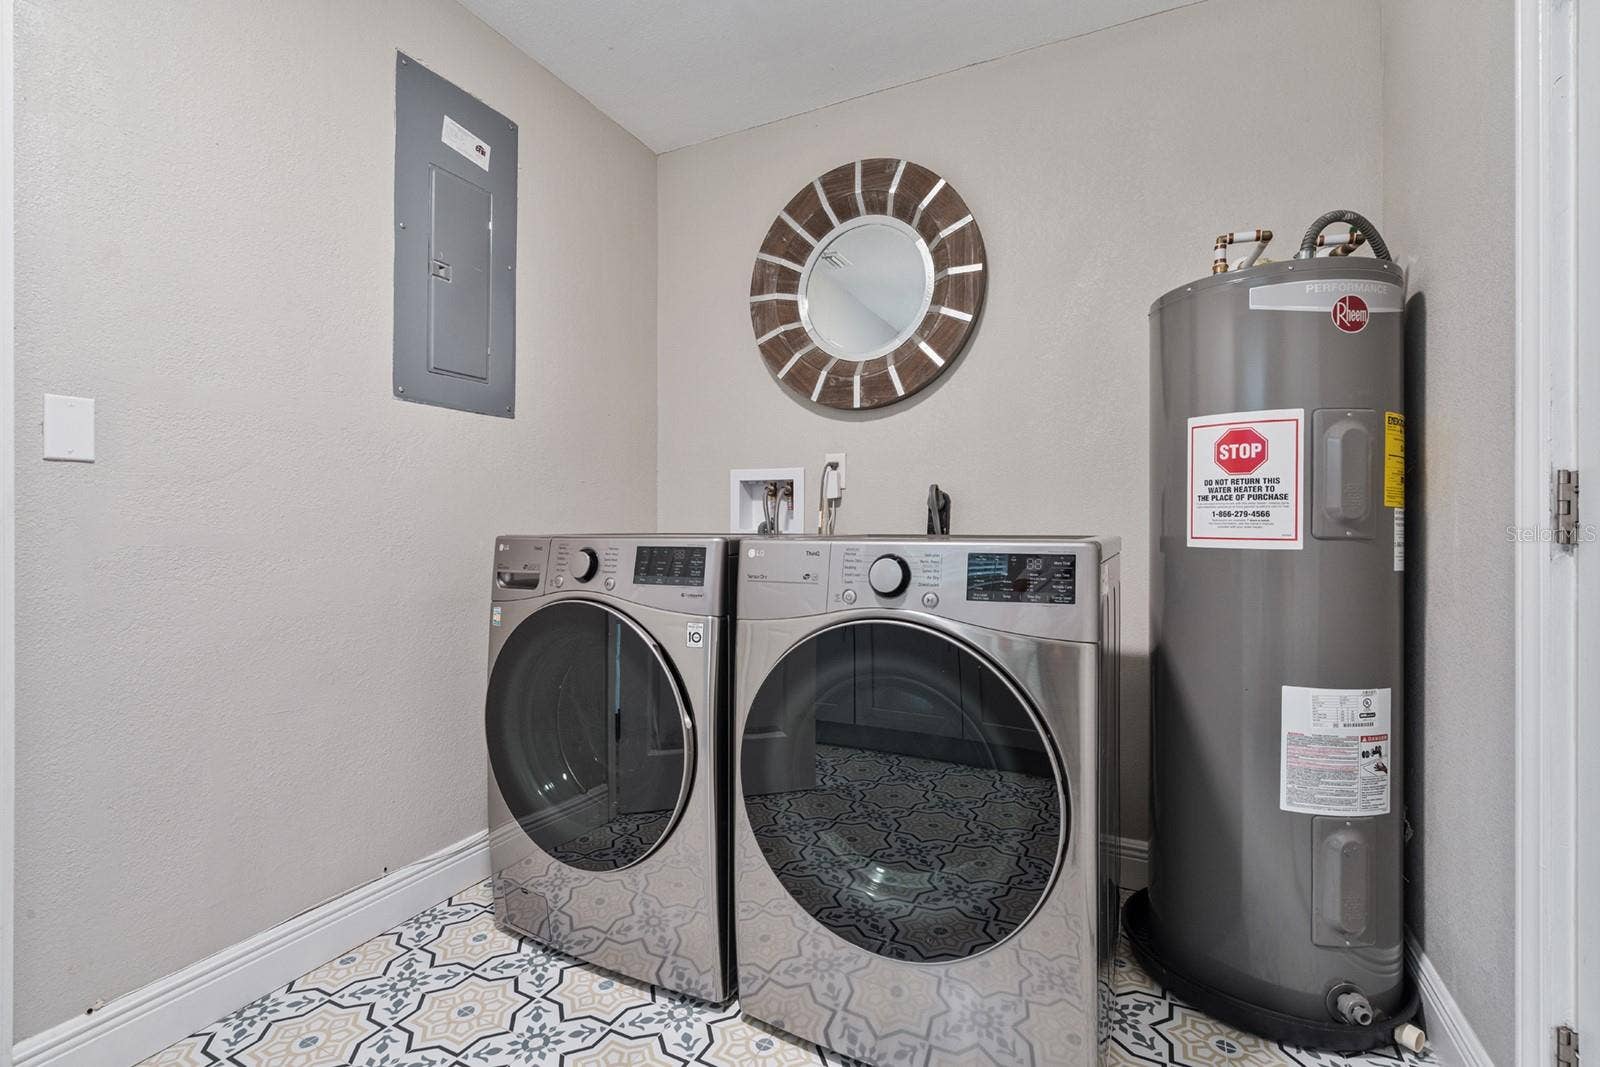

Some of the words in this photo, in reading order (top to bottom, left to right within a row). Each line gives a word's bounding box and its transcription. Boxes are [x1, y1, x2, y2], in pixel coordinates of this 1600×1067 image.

[1305, 281, 1388, 294] PERFORMANCE
[1336, 296, 1367, 327] Rheem
[1219, 443, 1262, 460] STOP
[1204, 479, 1213, 487] DO
[1230, 478, 1260, 486] RETURN
